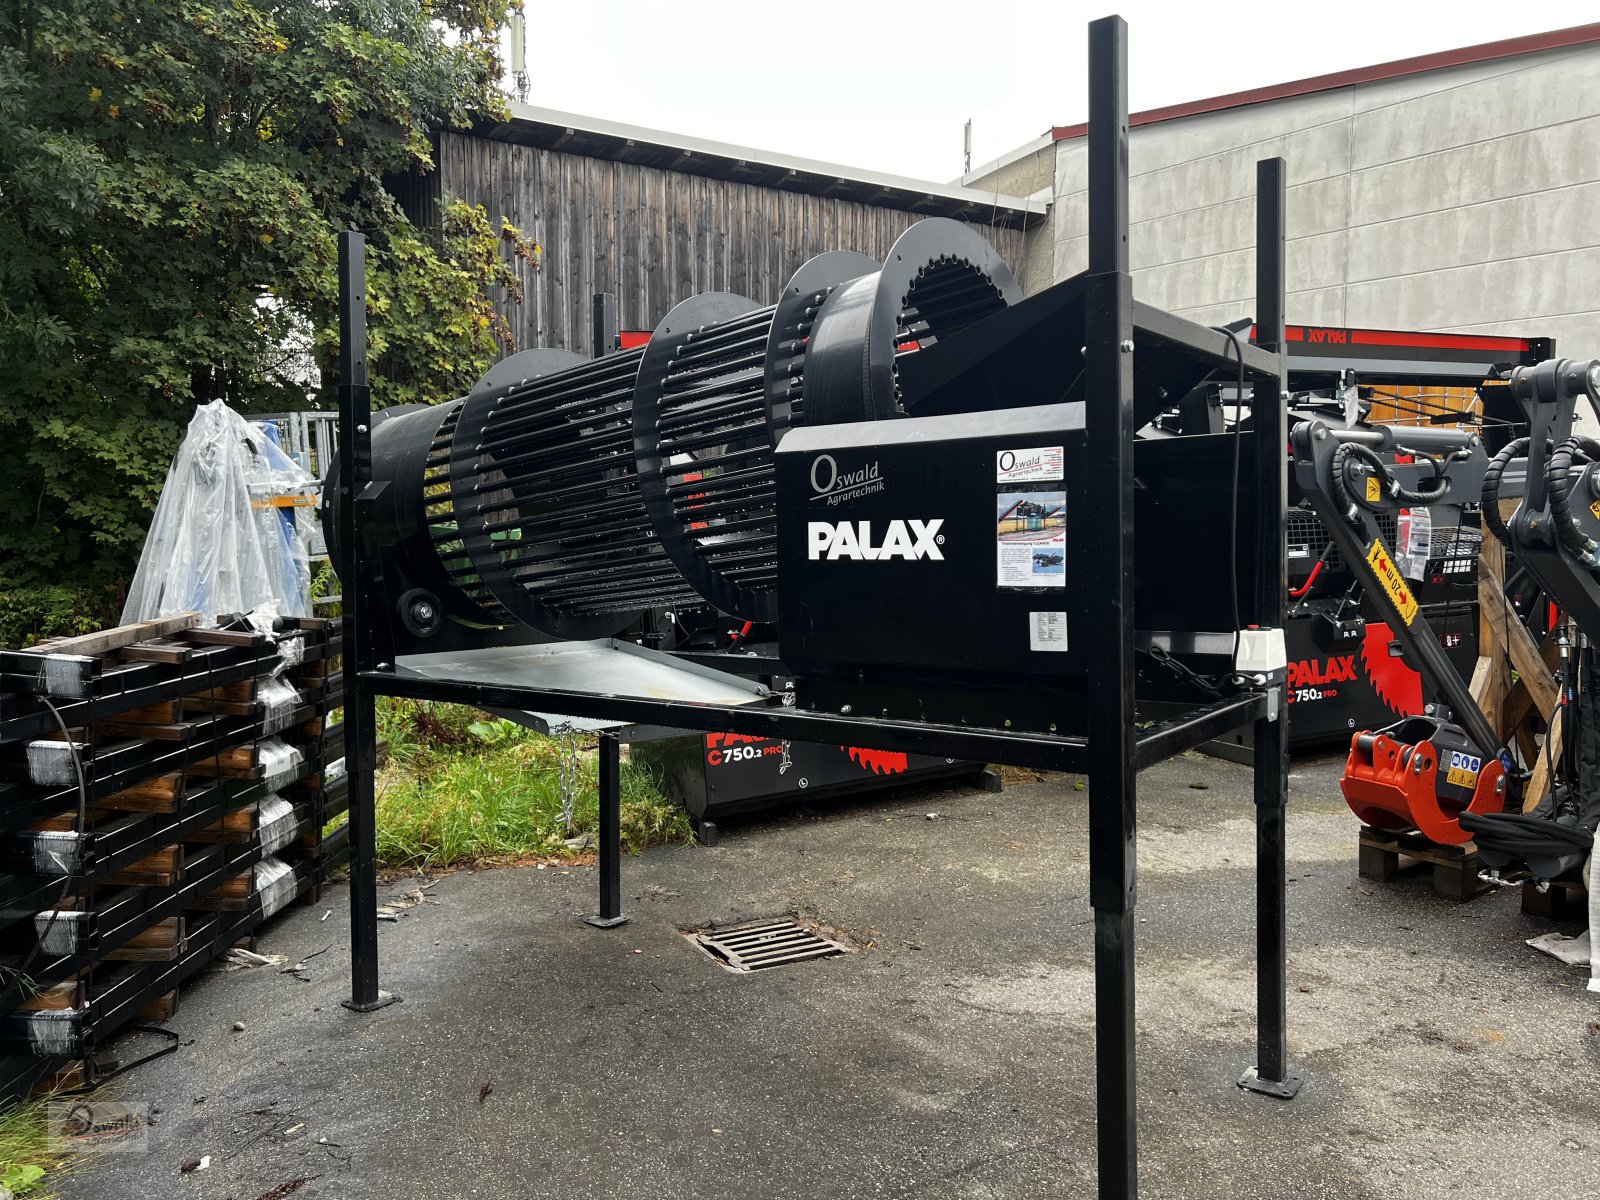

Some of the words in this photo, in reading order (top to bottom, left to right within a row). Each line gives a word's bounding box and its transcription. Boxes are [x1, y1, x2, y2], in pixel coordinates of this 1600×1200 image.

[1307, 328, 1347, 344] PALAX
[999, 451, 1040, 472] Oswald
[810, 454, 879, 493] Oswald
[826, 481, 885, 506] Agrartechnik
[1391, 579, 1401, 595] 20
[1323, 690, 1337, 698] PRO
